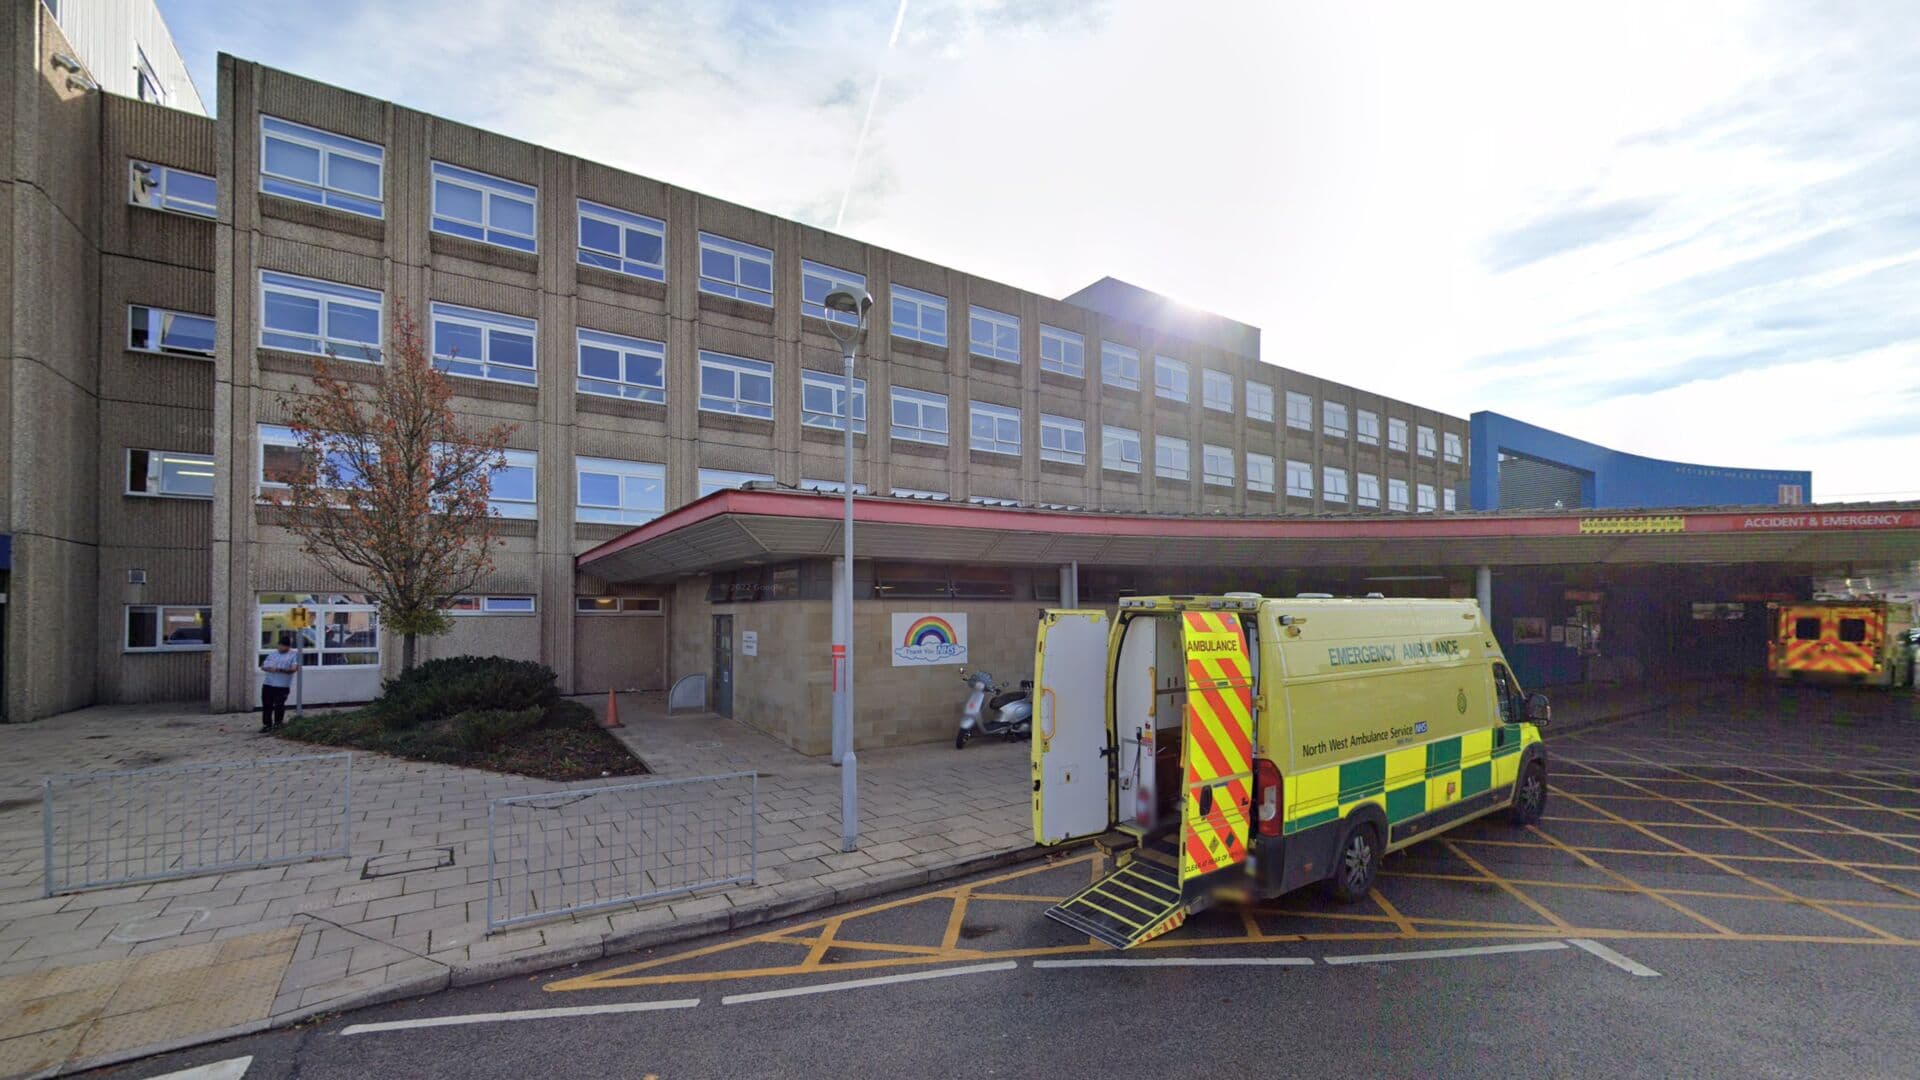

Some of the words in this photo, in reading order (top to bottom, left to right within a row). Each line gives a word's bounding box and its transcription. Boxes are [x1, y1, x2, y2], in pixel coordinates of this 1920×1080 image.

[1744, 516, 1805, 529] ACCIDENT
[1808, 516, 1818, 527] &
[1823, 514, 1902, 526] EMERGENCY
[1187, 640, 1238, 652] AMBULANCE
[1328, 644, 1396, 666] EMERGENCY
[1402, 640, 1460, 661] AMBULANCE
[1302, 741, 1327, 757] North
[1328, 738, 1349, 752] West
[1350, 730, 1389, 747] Ambulance
[1390, 725, 1414, 740] Service
